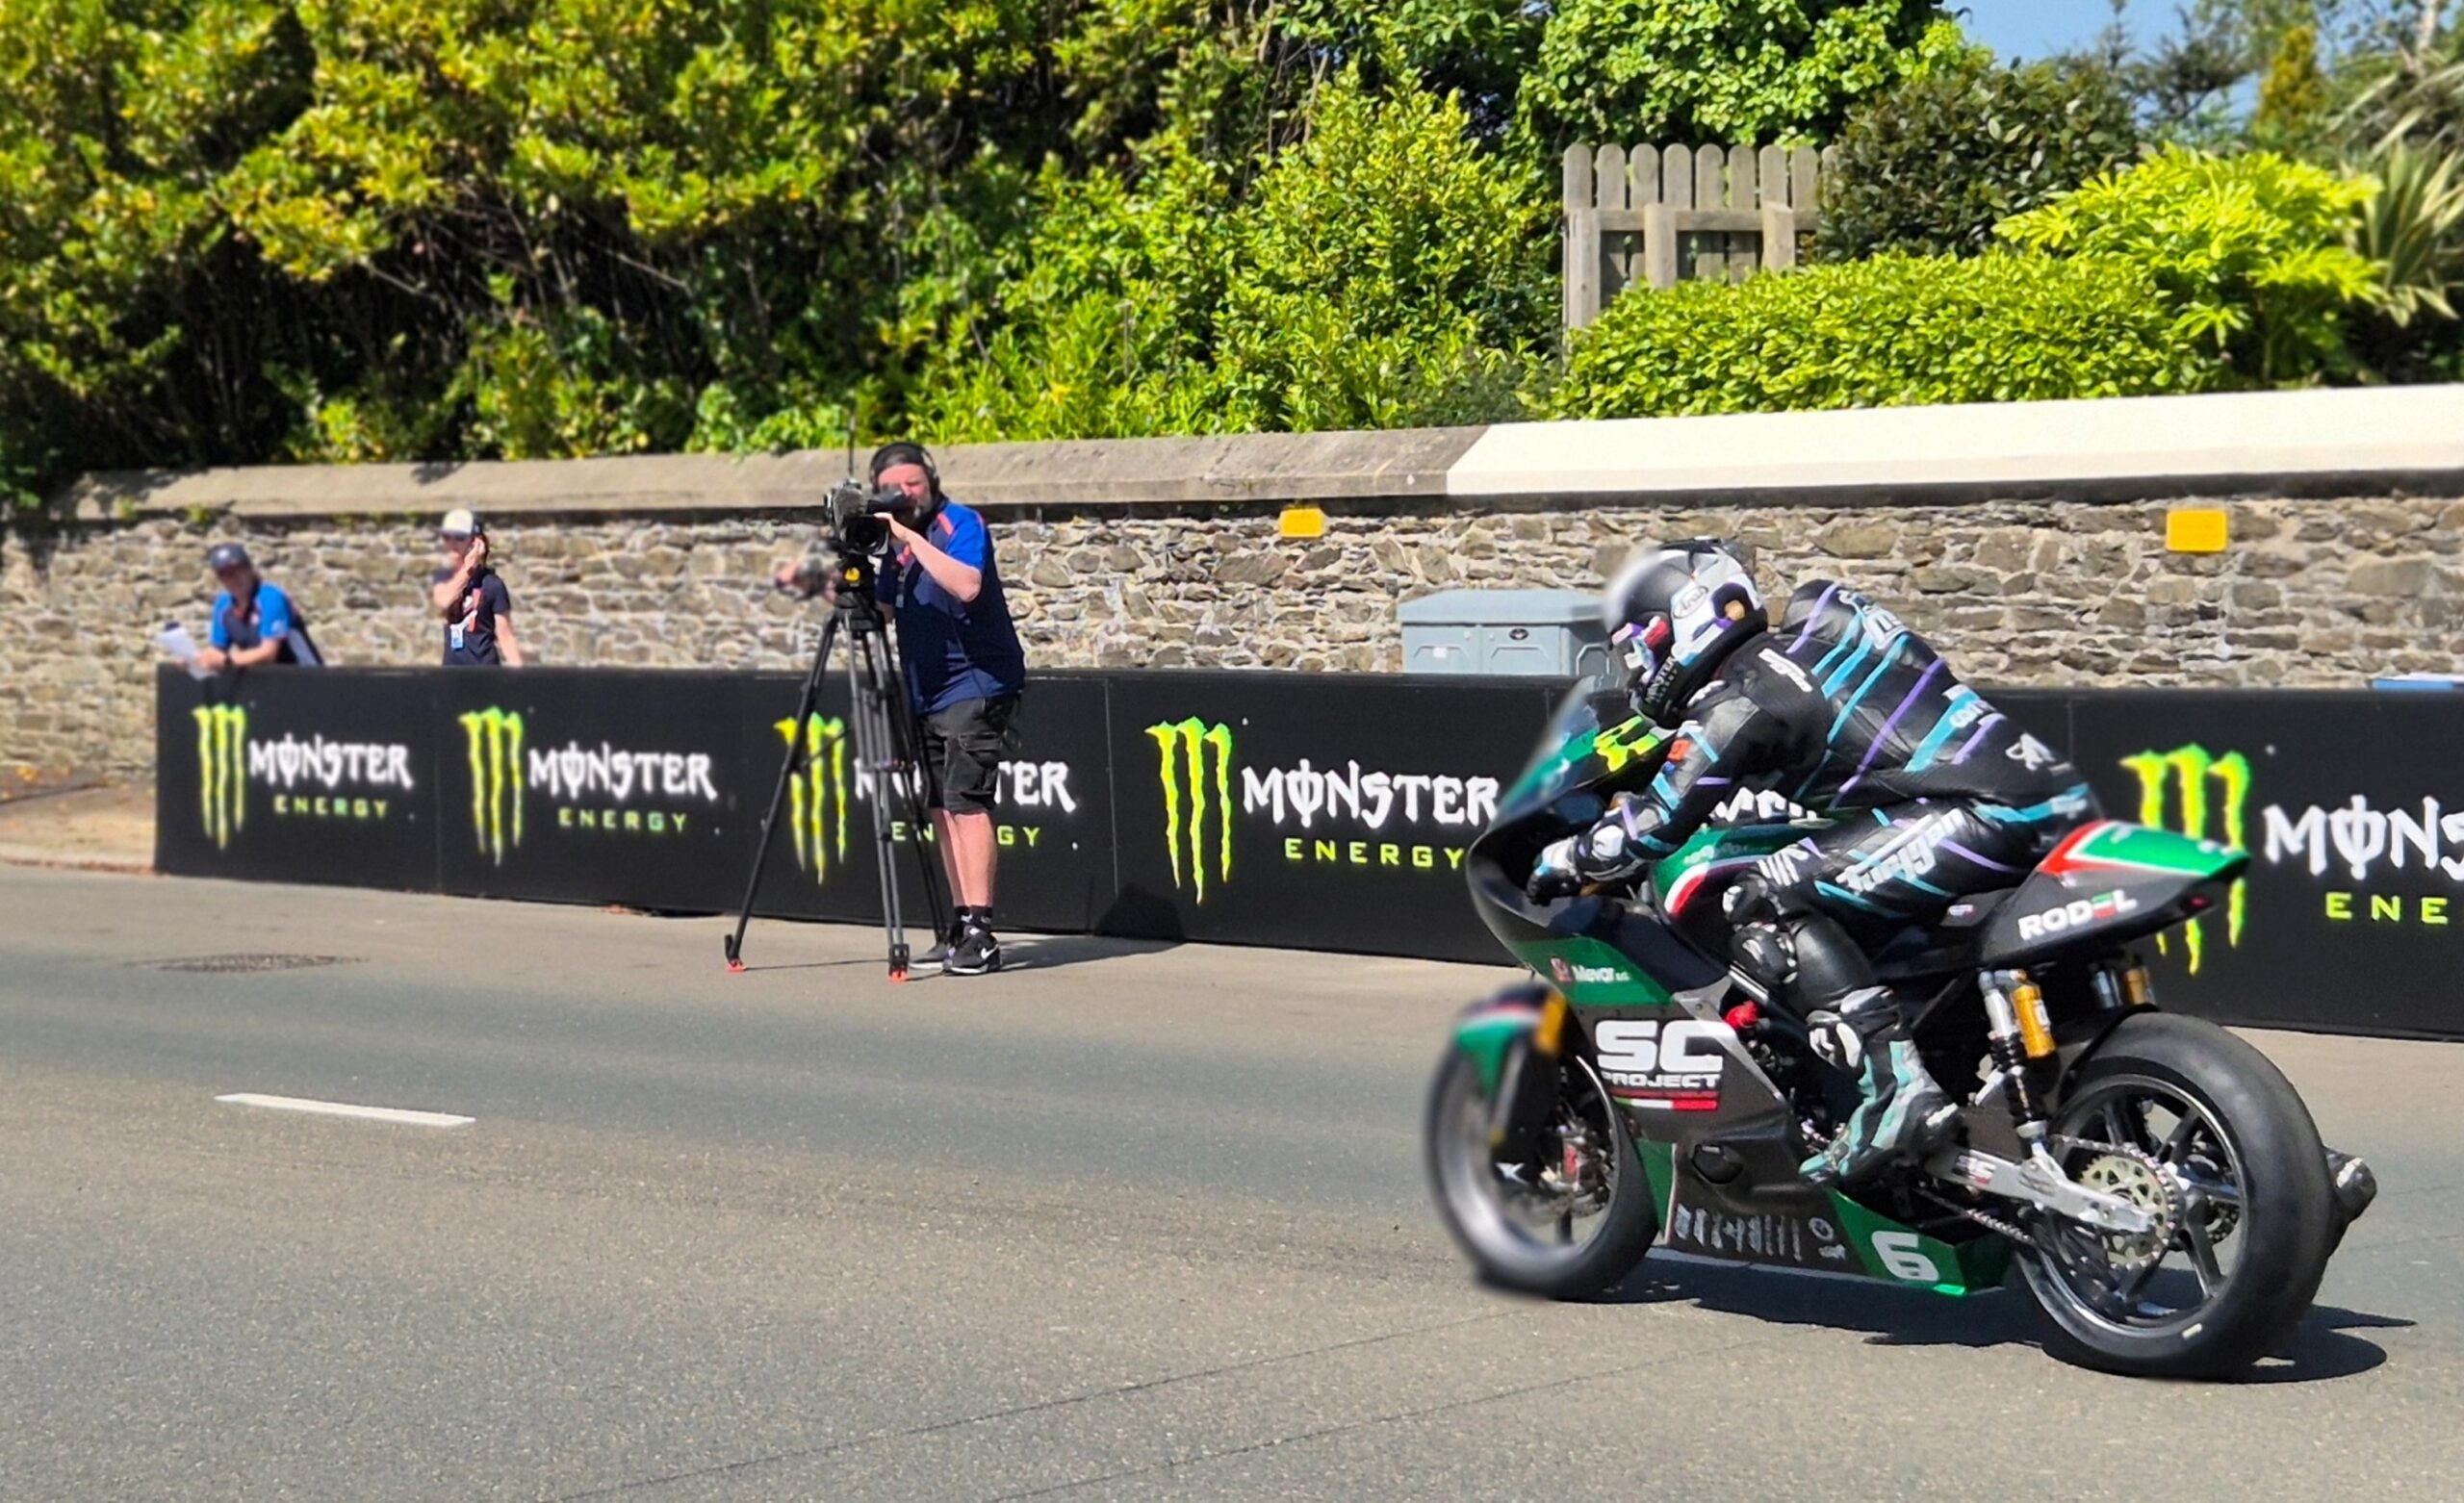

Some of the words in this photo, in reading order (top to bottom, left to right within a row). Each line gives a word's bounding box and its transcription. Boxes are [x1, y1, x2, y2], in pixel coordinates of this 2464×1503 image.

[248, 732, 415, 790] MONSTER
[527, 741, 719, 802] MONSTER
[273, 795, 388, 819] ENERGY
[1241, 758, 1500, 829] MONSTER
[557, 807, 686, 833] ENERGY
[890, 821, 1040, 848] ENGY
[1284, 837, 1465, 870] ENERGY
[1595, 1019, 1736, 1072] SC
[1601, 1070, 1722, 1088] PROJECT
[1870, 1230, 1940, 1282] 6
